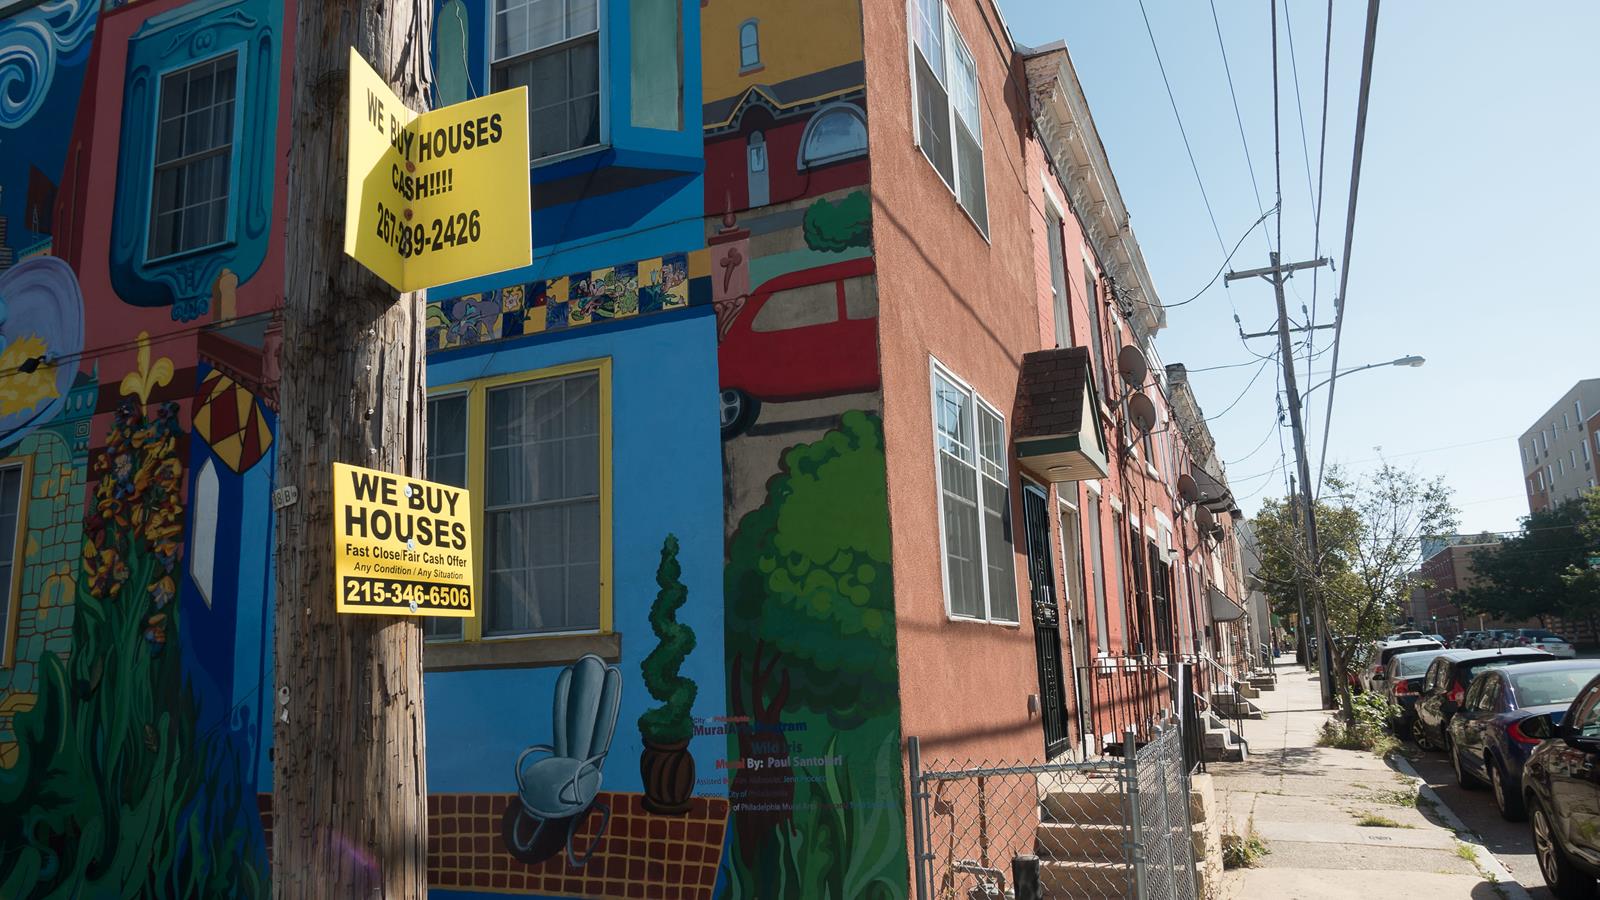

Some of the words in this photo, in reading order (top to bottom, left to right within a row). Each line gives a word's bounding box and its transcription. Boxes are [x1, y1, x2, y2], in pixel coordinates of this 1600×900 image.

[367, 87, 384, 135] WE
[390, 113, 415, 161] BUY
[419, 113, 503, 163] HOUSES
[392, 163, 453, 201] CASH!!!!
[376, 202, 481, 259] 267-289-2426
[351, 471, 398, 507] WE
[407, 482, 459, 517] BUY
[345, 504, 467, 551] HOUSES
[346, 543, 370, 558] Fast
[423, 551, 445, 566] Cash
[447, 555, 467, 568] Offer
[354, 561, 371, 574] Any
[374, 563, 412, 576] Condition
[417, 567, 432, 580] Any
[434, 569, 463, 580] Situation
[346, 580, 470, 607] 215-346-6506
[746, 757, 764, 772] By:
[768, 756, 791, 768] Paul
